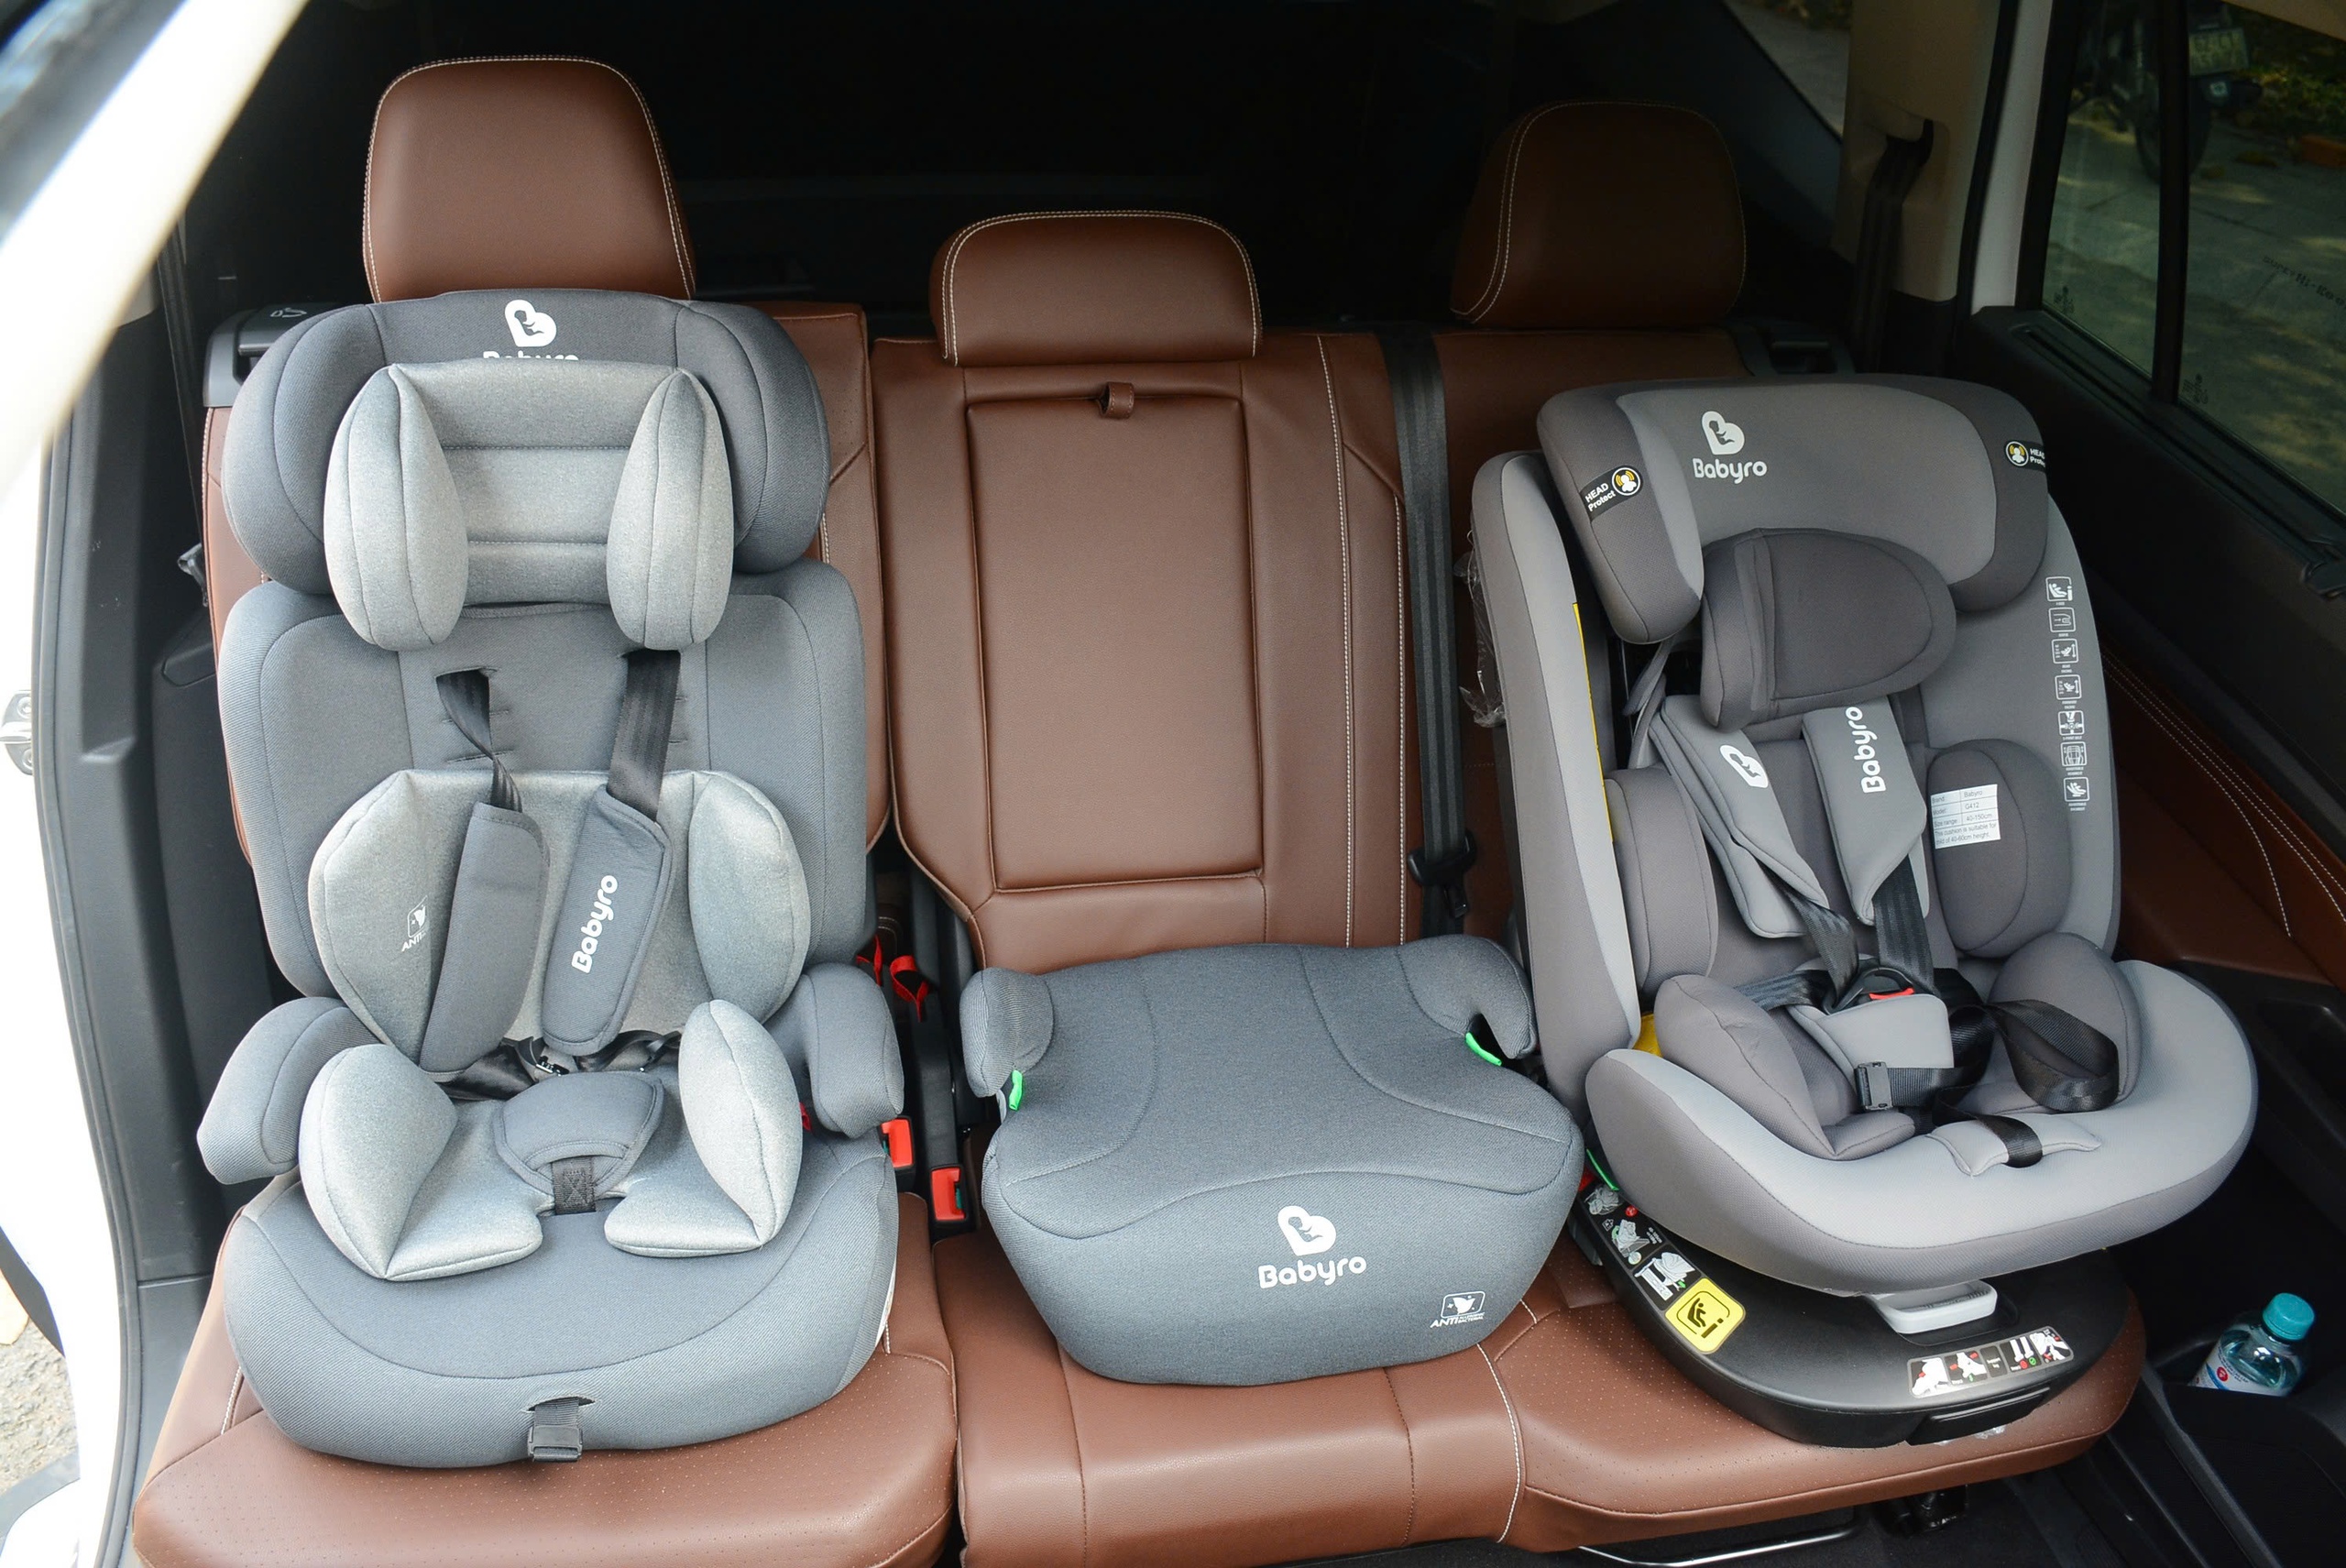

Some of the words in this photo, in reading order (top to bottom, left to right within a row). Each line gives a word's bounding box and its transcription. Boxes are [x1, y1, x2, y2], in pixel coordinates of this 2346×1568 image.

[1693, 457, 1768, 484] Babyro
[1584, 483, 1609, 503] HEAD
[1587, 489, 1617, 512] Protect
[1846, 707, 1886, 794] Babyro
[572, 875, 618, 973] Babyro
[1258, 1256, 1366, 1288] Babyro
[1430, 1317, 1459, 1328] ANTI
